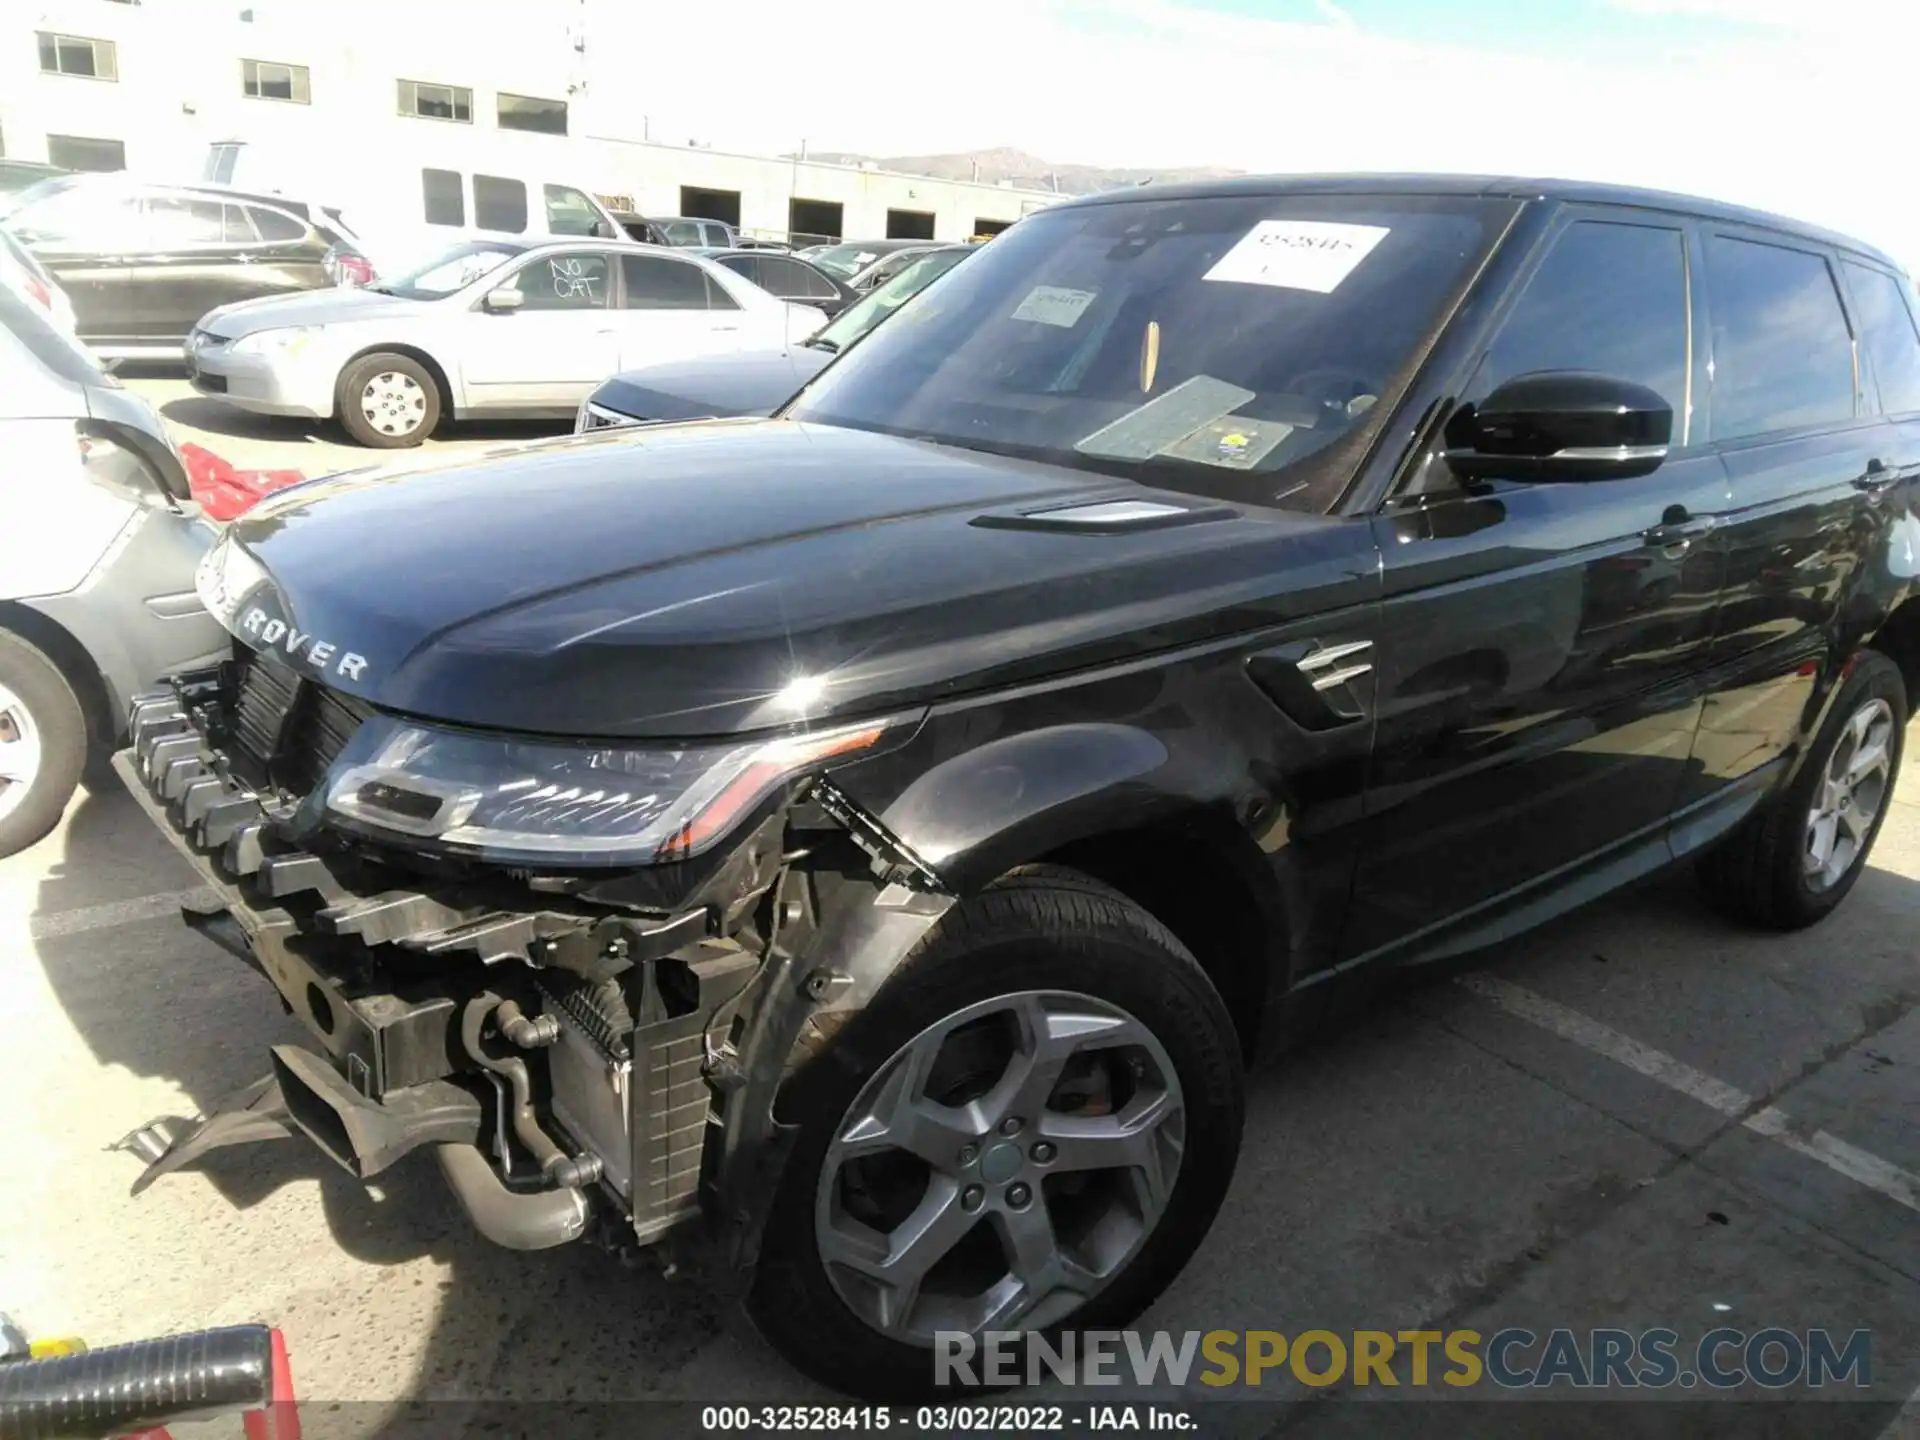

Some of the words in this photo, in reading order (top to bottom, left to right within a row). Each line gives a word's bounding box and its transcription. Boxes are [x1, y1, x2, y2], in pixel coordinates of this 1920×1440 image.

[551, 258, 582, 277] NO
[554, 277, 600, 297] CAT
[243, 608, 368, 682] ROVER
